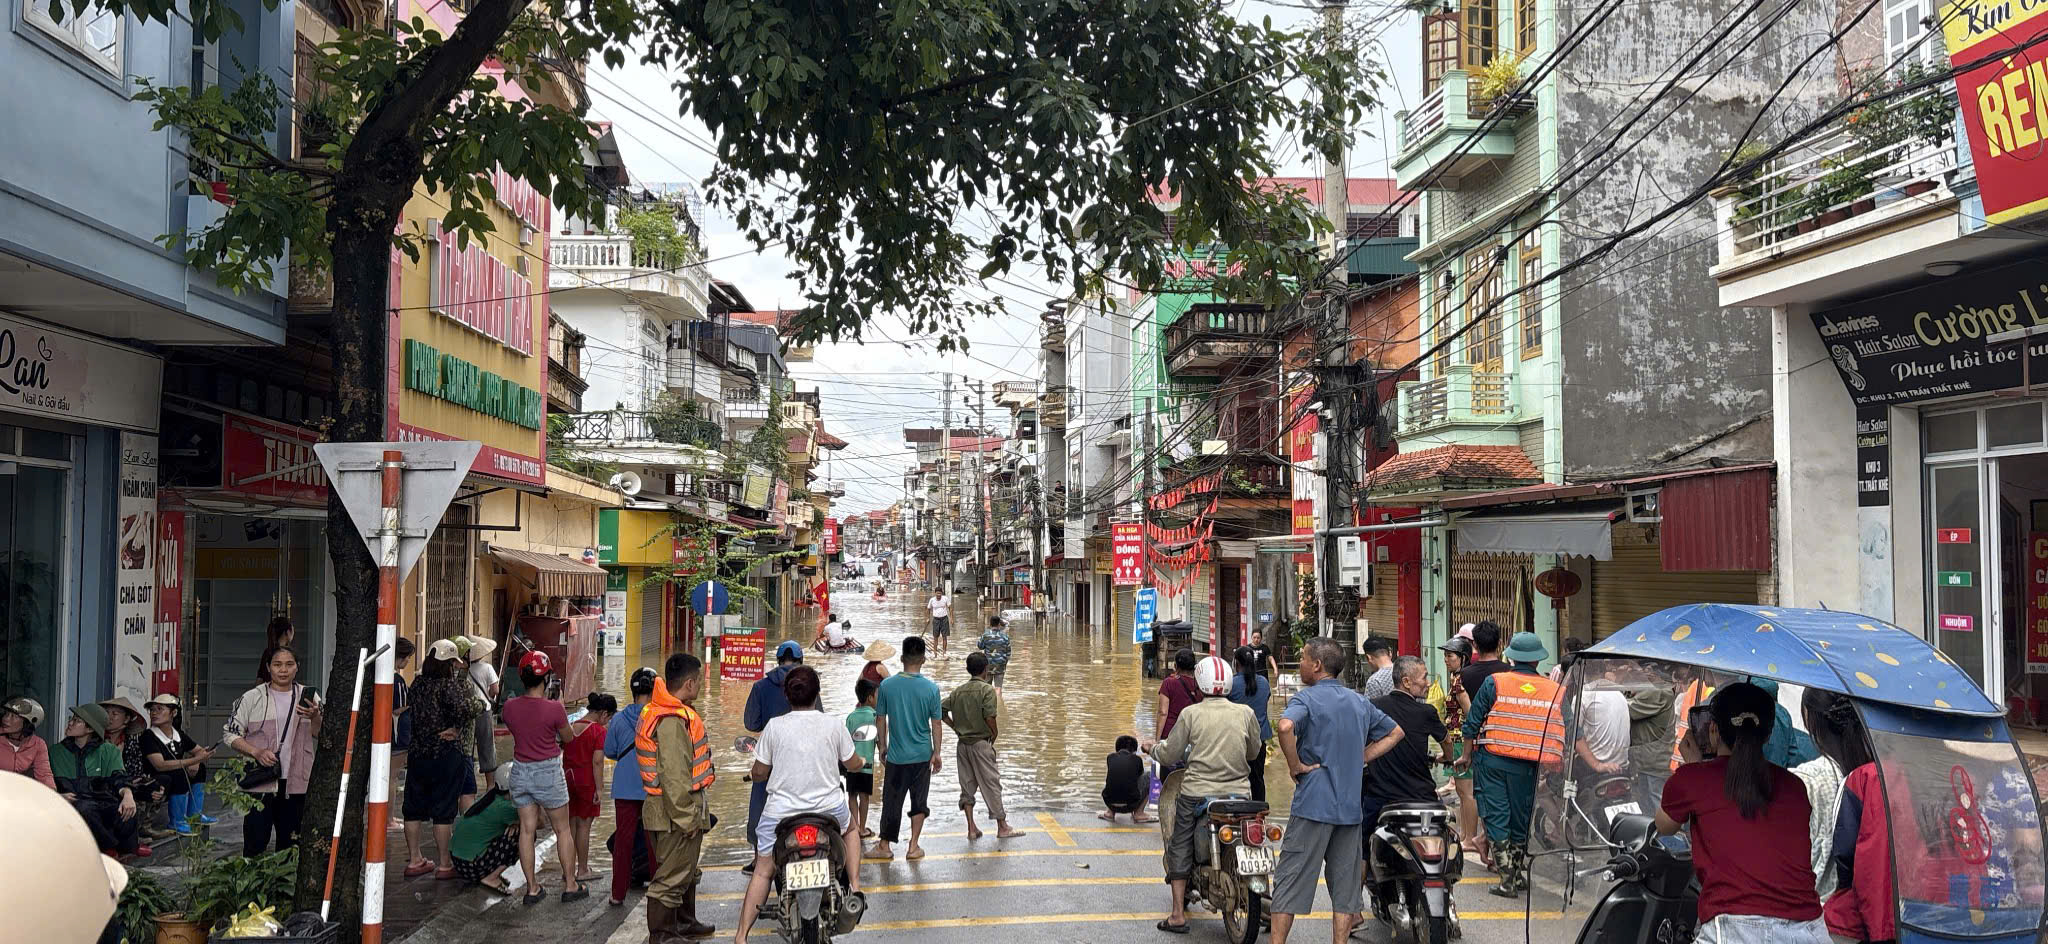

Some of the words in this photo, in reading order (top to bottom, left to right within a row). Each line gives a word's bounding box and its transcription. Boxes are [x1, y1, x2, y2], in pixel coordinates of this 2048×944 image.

[1820, 315, 1880, 336] davines
[1913, 303, 2024, 346] Cường
[1854, 337, 1880, 356] Hair
[1884, 333, 1920, 351] Salon
[23, 392, 36, 405] Nail
[38, 395, 44, 406] &
[1865, 461, 1877, 474] KHU
[1876, 460, 1881, 473] 3
[124, 613, 146, 635] CHÂN
[725, 655, 738, 664] XE
[740, 654, 763, 666] MÁY
[793, 861, 821, 875] 12-T1
[789, 873, 826, 888] 231.22
